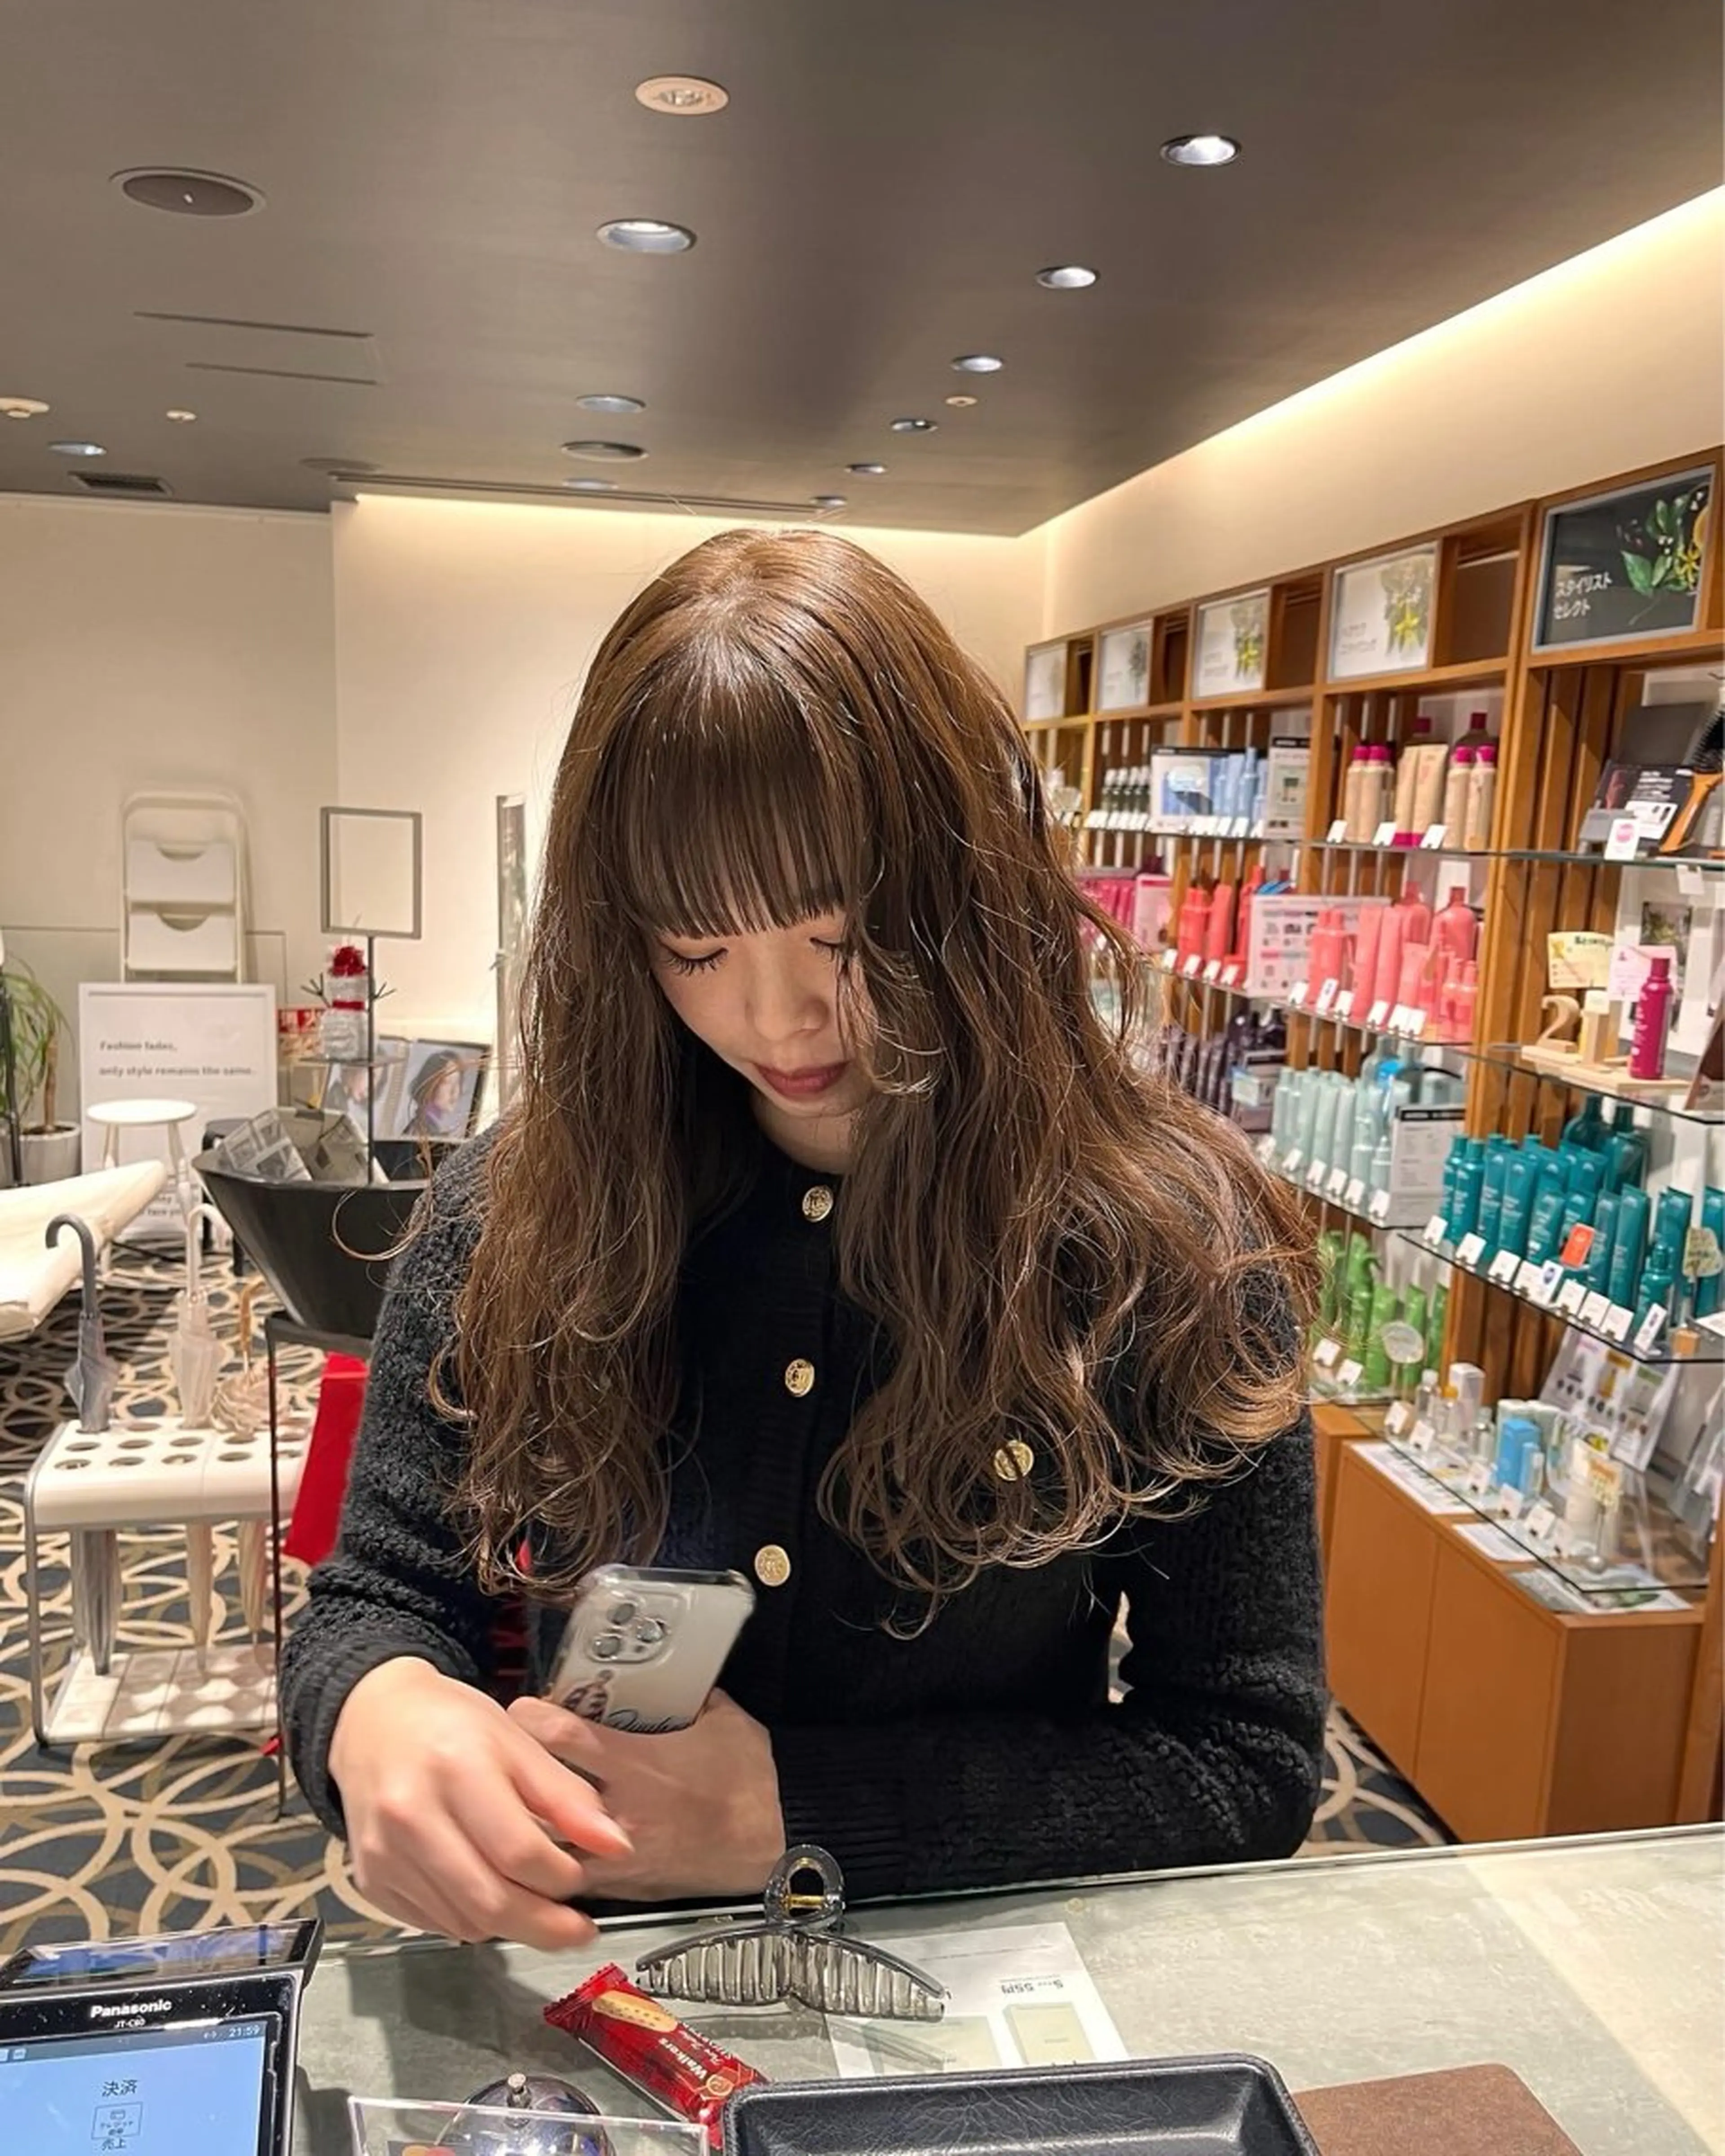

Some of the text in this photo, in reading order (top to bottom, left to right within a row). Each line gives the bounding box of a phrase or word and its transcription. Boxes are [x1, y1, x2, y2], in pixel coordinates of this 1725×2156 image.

[1556, 571, 1613, 598] スタイリスト
[1553, 598, 1591, 620] セレクト
[100, 1040, 142, 1052] Fashion
[90, 1999, 172, 2018] Panasonic
[229, 2024, 261, 2038] 21:59
[658, 2037, 708, 2080] Walkers
[102, 2079, 138, 2097] 決済
[102, 2138, 127, 2151] 売上
